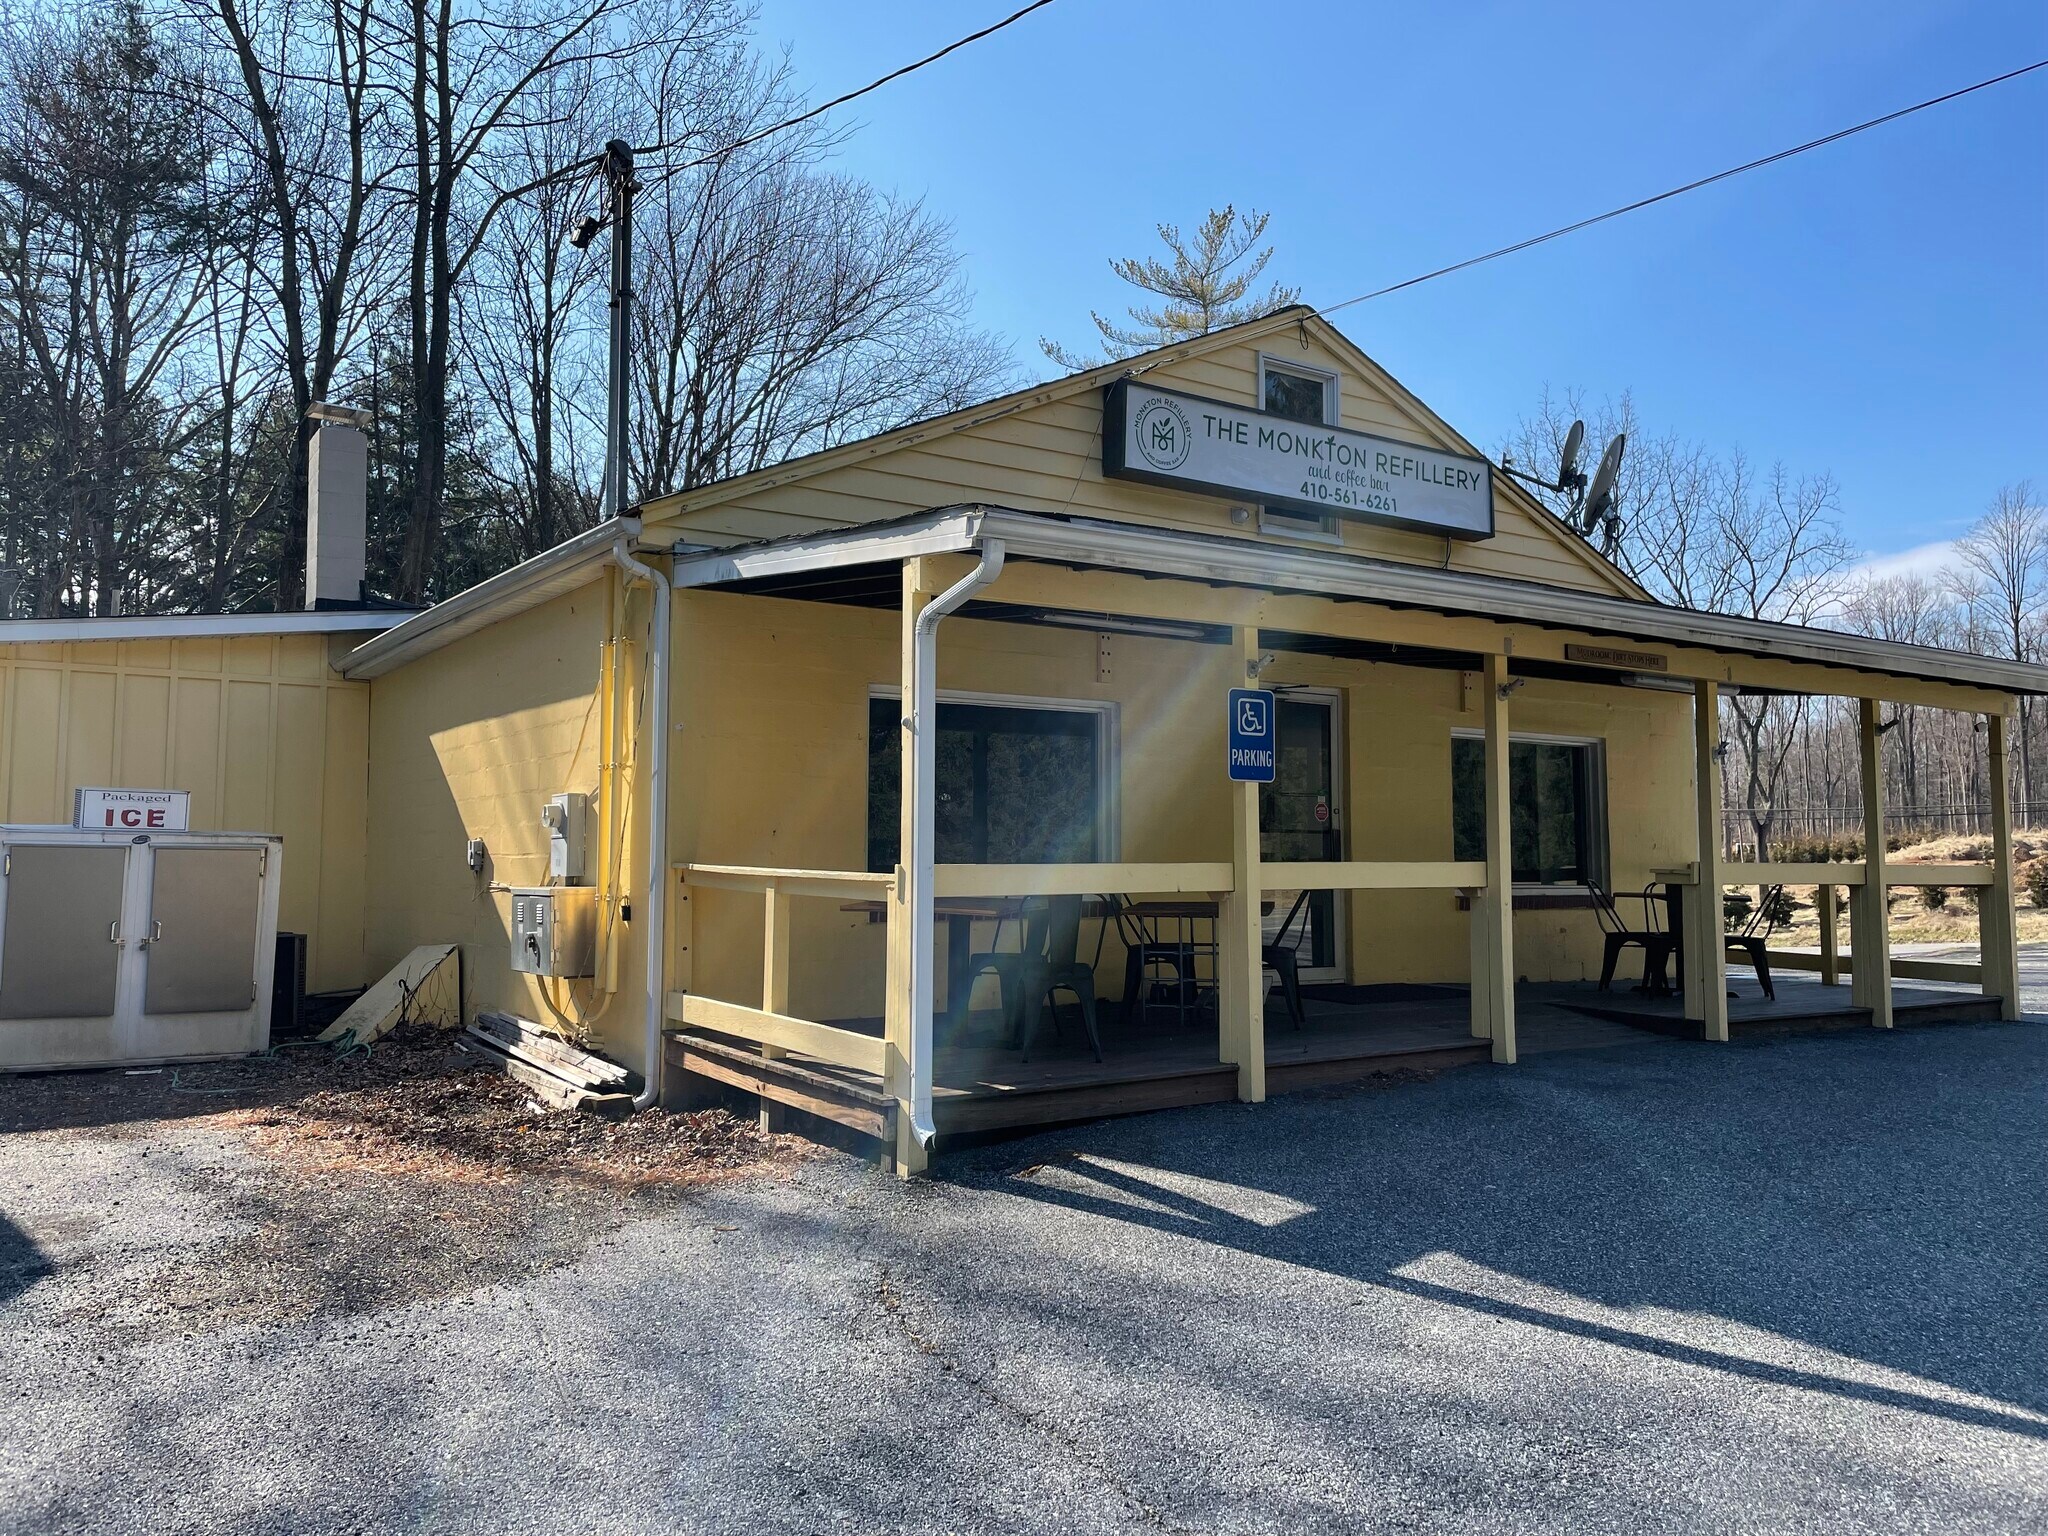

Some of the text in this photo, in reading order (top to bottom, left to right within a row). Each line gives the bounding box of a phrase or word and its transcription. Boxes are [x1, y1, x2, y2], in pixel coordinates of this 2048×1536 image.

[1134, 398, 1192, 440] MONKTON REFILLERY
[1203, 414, 1481, 492] THE MONKTON REFILLERY
[1308, 464, 1392, 493] and coffee bar
[1300, 481, 1398, 512] 410-561-6261
[1231, 748, 1272, 768] PARKING
[102, 792, 171, 804] Packaged
[105, 808, 166, 828] ICE
